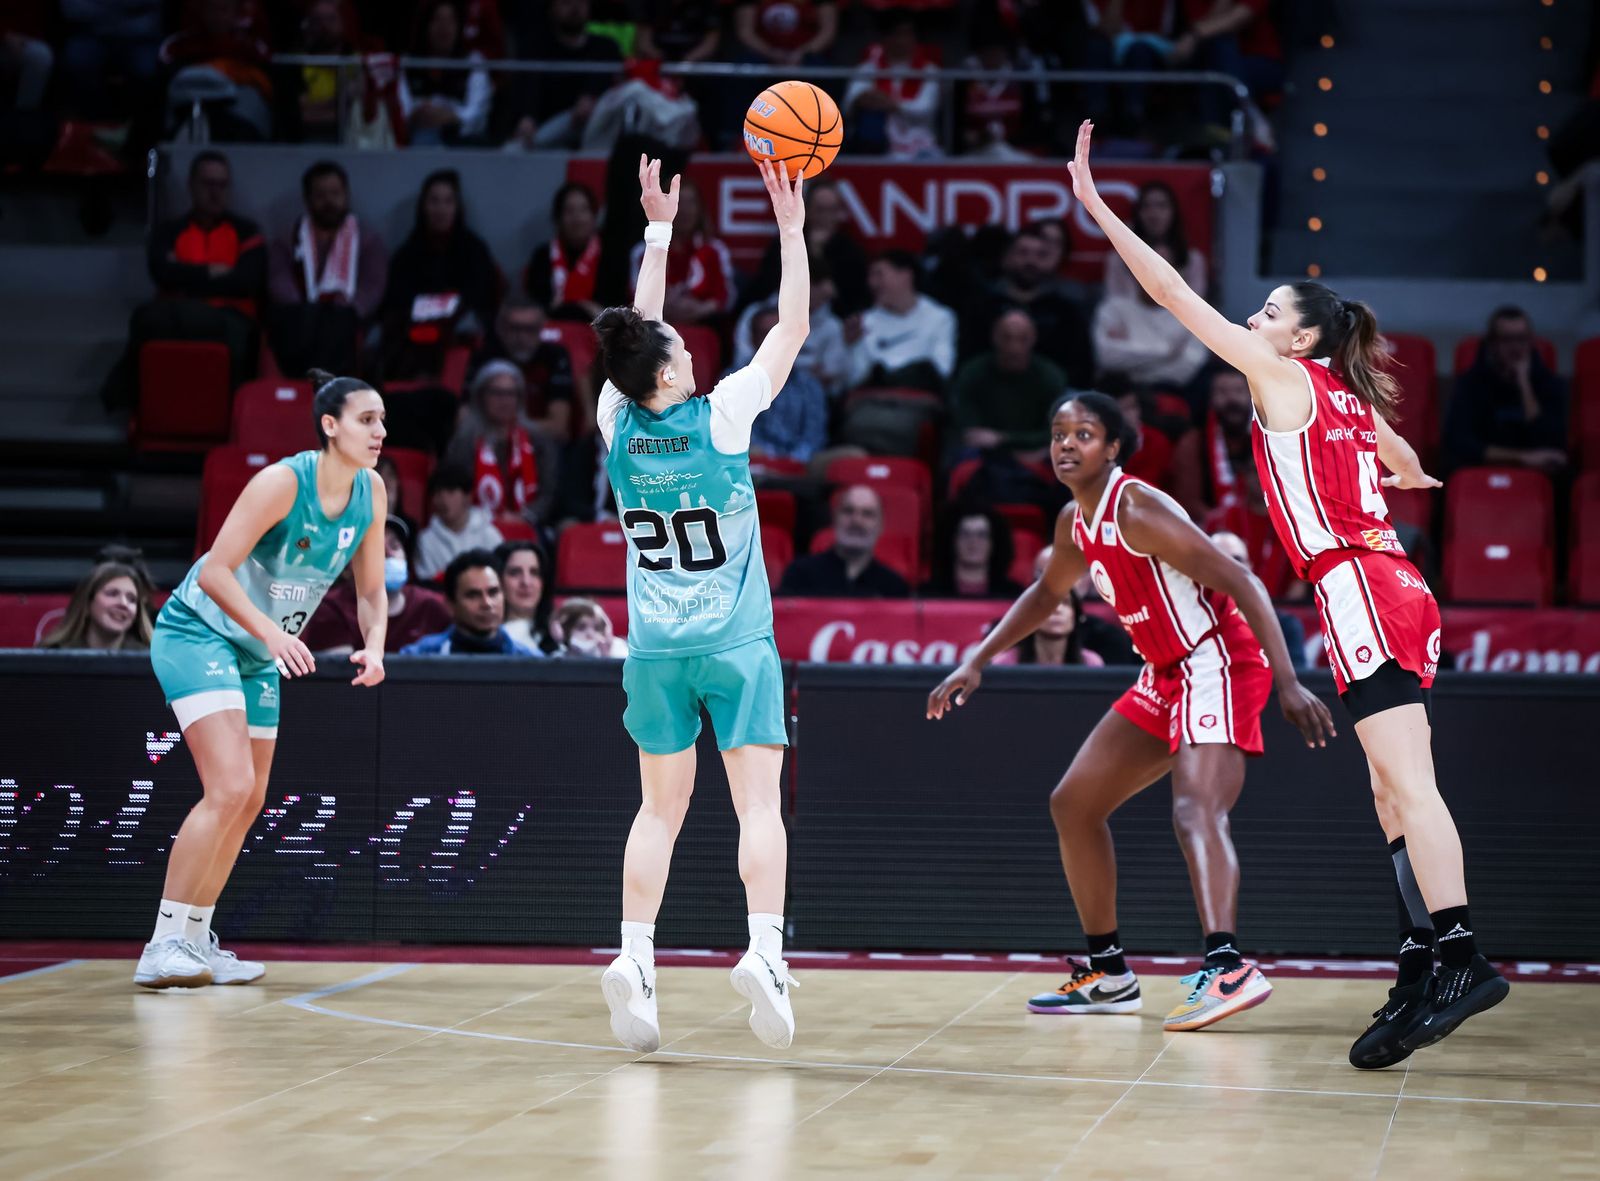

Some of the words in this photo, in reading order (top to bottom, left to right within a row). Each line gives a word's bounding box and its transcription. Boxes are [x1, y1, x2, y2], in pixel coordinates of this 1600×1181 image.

[1325, 428, 1344, 442] AIR
[628, 436, 689, 454] GRETTER
[623, 507, 728, 572] 20
[268, 583, 306, 601] SGM
[643, 595, 733, 615] COMPITE
